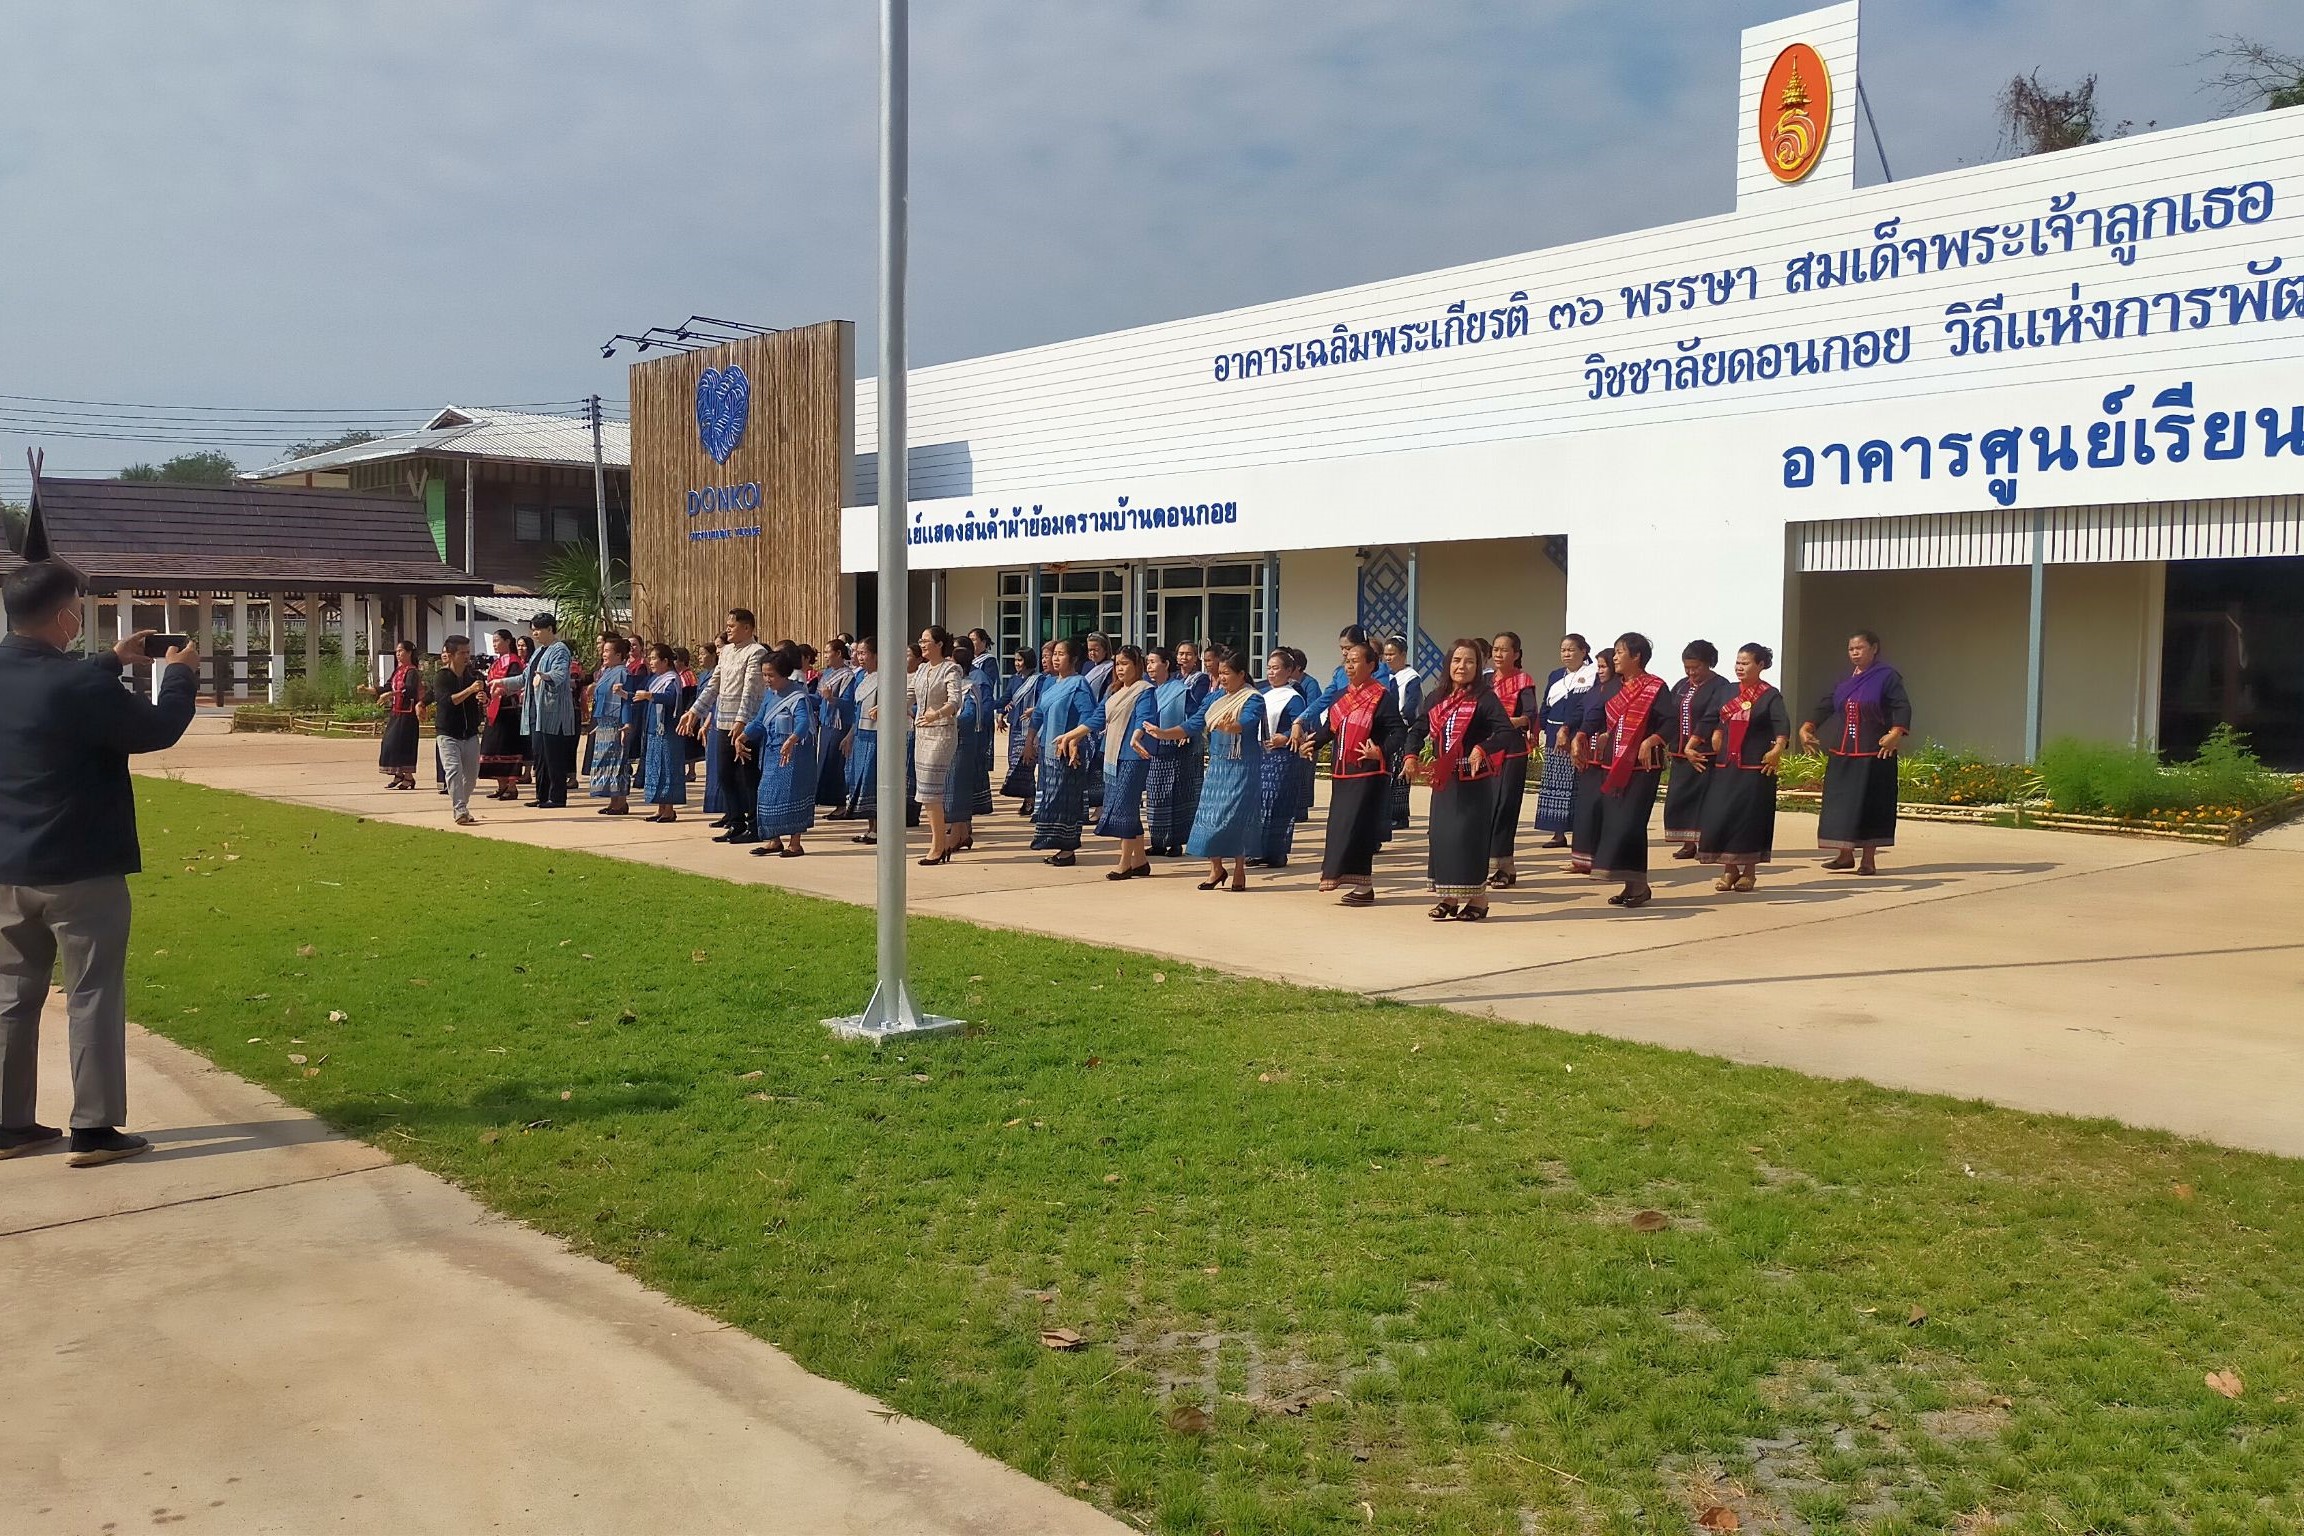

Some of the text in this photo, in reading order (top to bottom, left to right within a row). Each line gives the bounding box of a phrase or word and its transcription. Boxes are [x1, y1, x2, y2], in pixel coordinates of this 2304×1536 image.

[1215, 179, 2275, 381] อาคารเฉลิมพระเกียรติ ๓๖ พรรษา สมเด็จพระเจ้าลูกเธอ
[1584, 326, 1911, 401] วิชชาลัยดอนกอย
[1783, 381, 2304, 507] อาคารศูนย์เรียน
[687, 481, 762, 516] DONKOI
